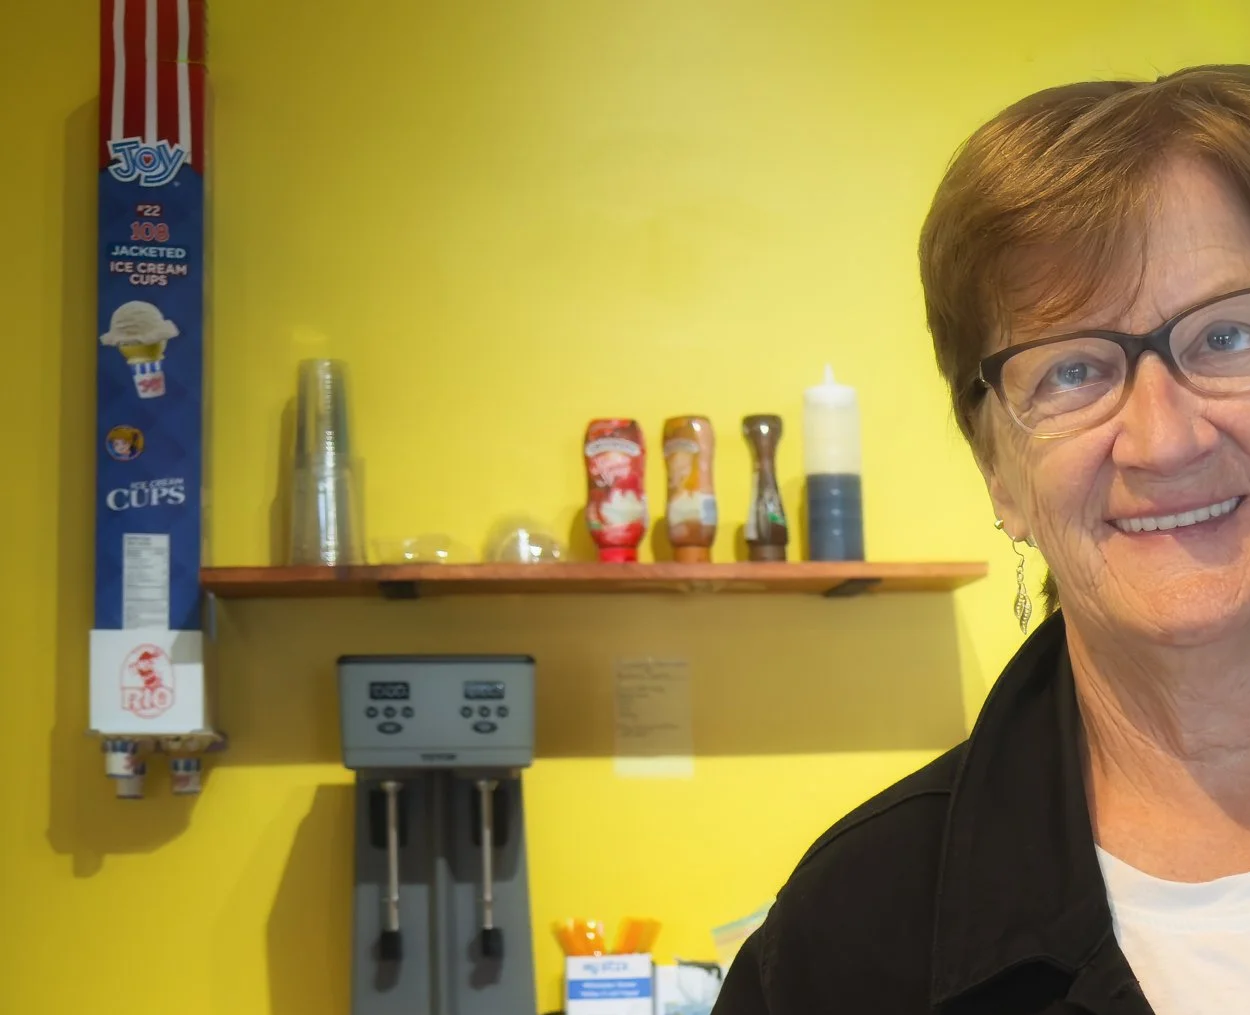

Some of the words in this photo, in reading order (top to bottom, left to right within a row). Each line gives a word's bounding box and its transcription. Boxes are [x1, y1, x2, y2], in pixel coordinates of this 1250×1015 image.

[111, 245, 187, 259] JACKETED
[110, 261, 134, 273] ICE
[136, 262, 188, 275] CREAM
[129, 274, 168, 286] CUPS
[106, 486, 185, 512] CUPS
